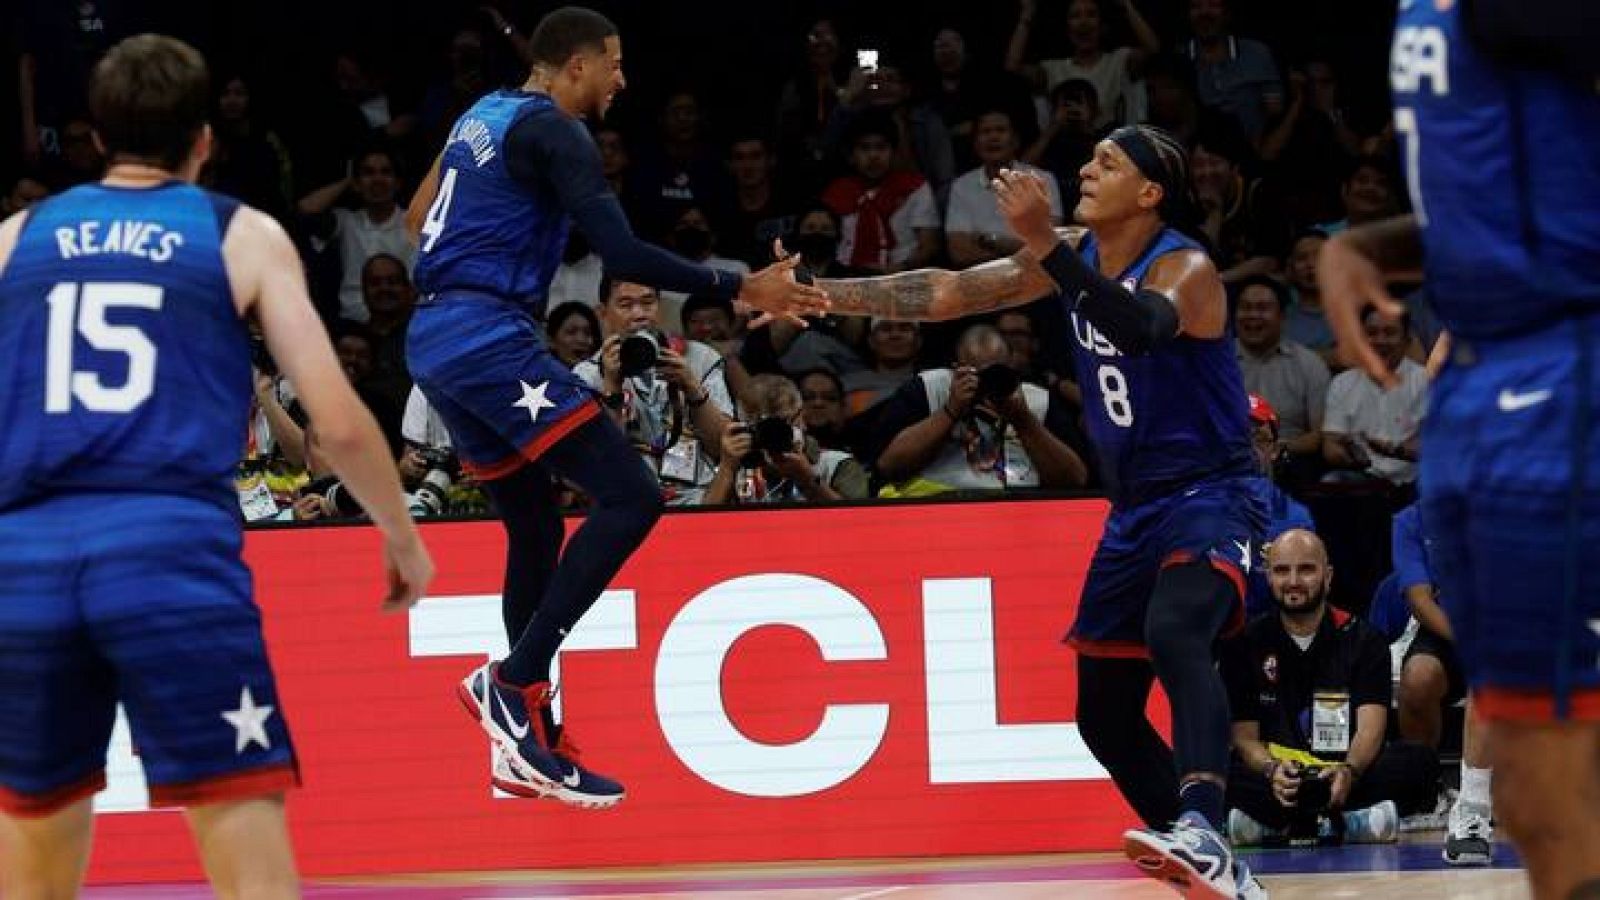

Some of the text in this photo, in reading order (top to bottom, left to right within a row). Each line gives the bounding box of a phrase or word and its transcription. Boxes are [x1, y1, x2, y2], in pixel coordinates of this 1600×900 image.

[55, 220, 183, 262] REAVES
[421, 168, 458, 252] 4
[45, 281, 164, 414] 15
[1070, 311, 1124, 356] US
[1097, 364, 1134, 427] 8
[408, 573, 1112, 798] TCL
